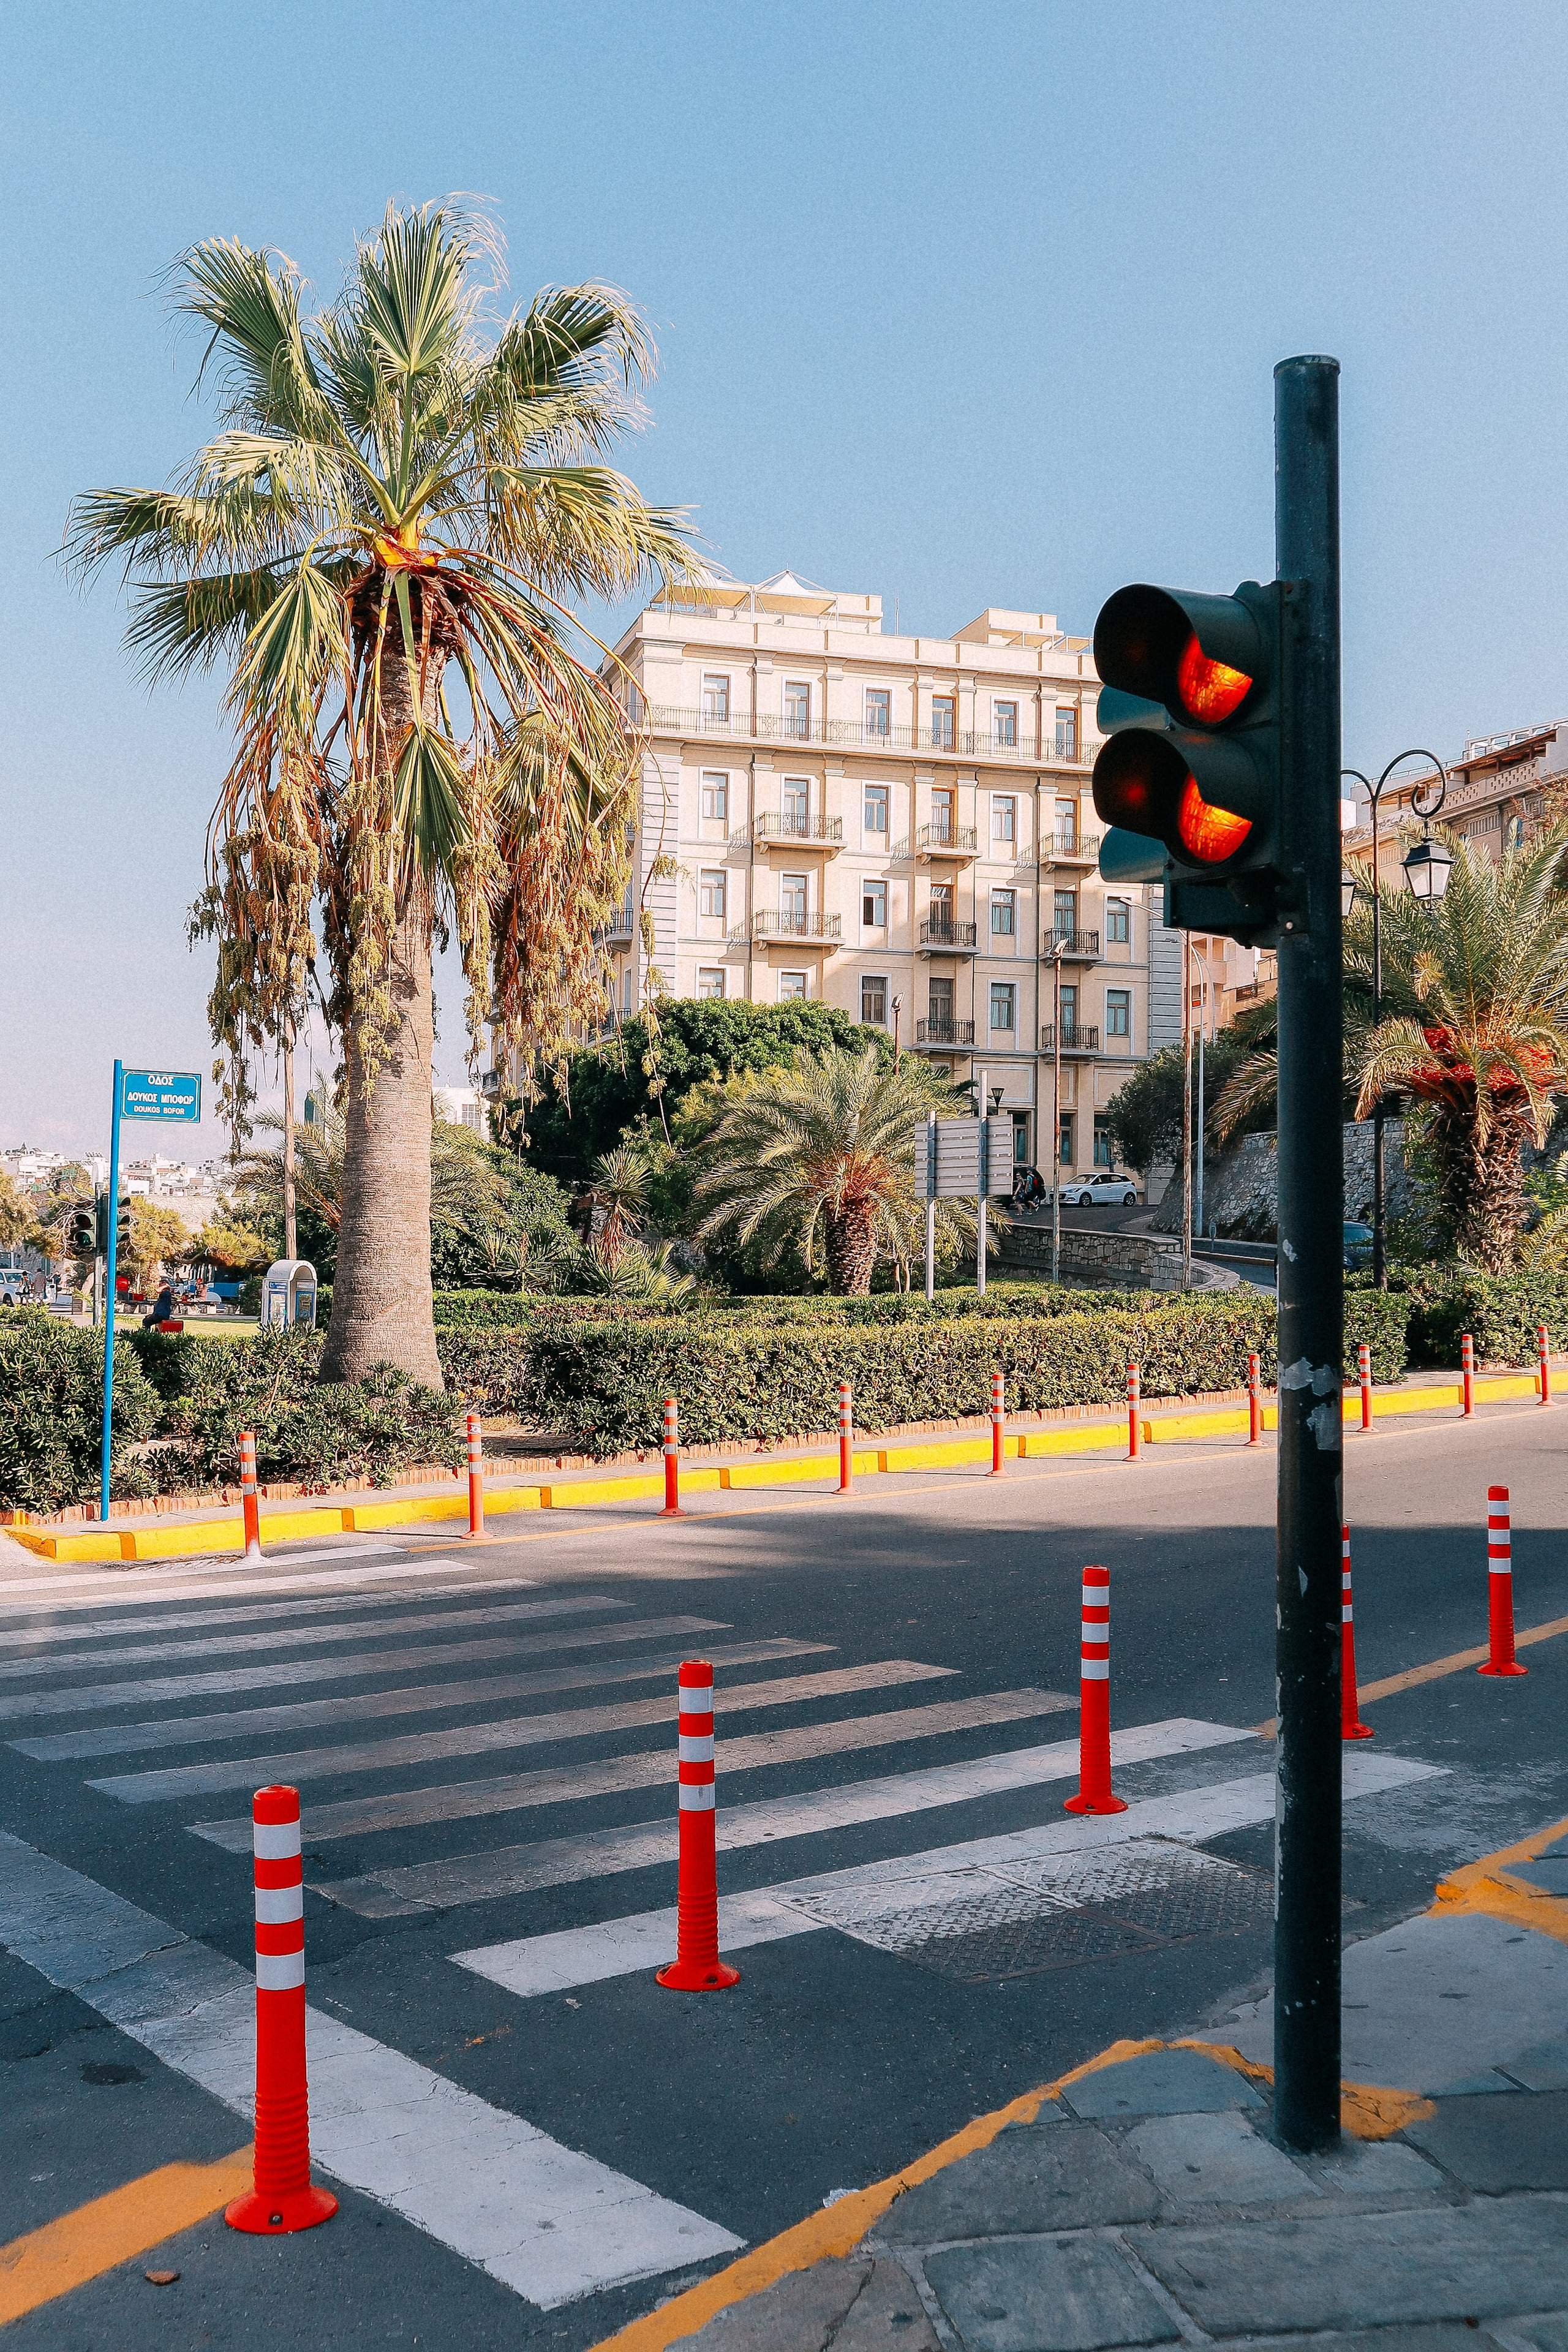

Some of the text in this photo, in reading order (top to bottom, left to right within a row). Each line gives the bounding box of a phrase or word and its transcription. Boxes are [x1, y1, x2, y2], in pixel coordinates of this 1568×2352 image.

[148, 1075, 174, 1086] ΟΔΟΣ
[127, 1091, 194, 1104] ΔΟΥΚΟΣ ΜΠΟΦΩΡ
[134, 1105, 160, 1114] DOUKOS
